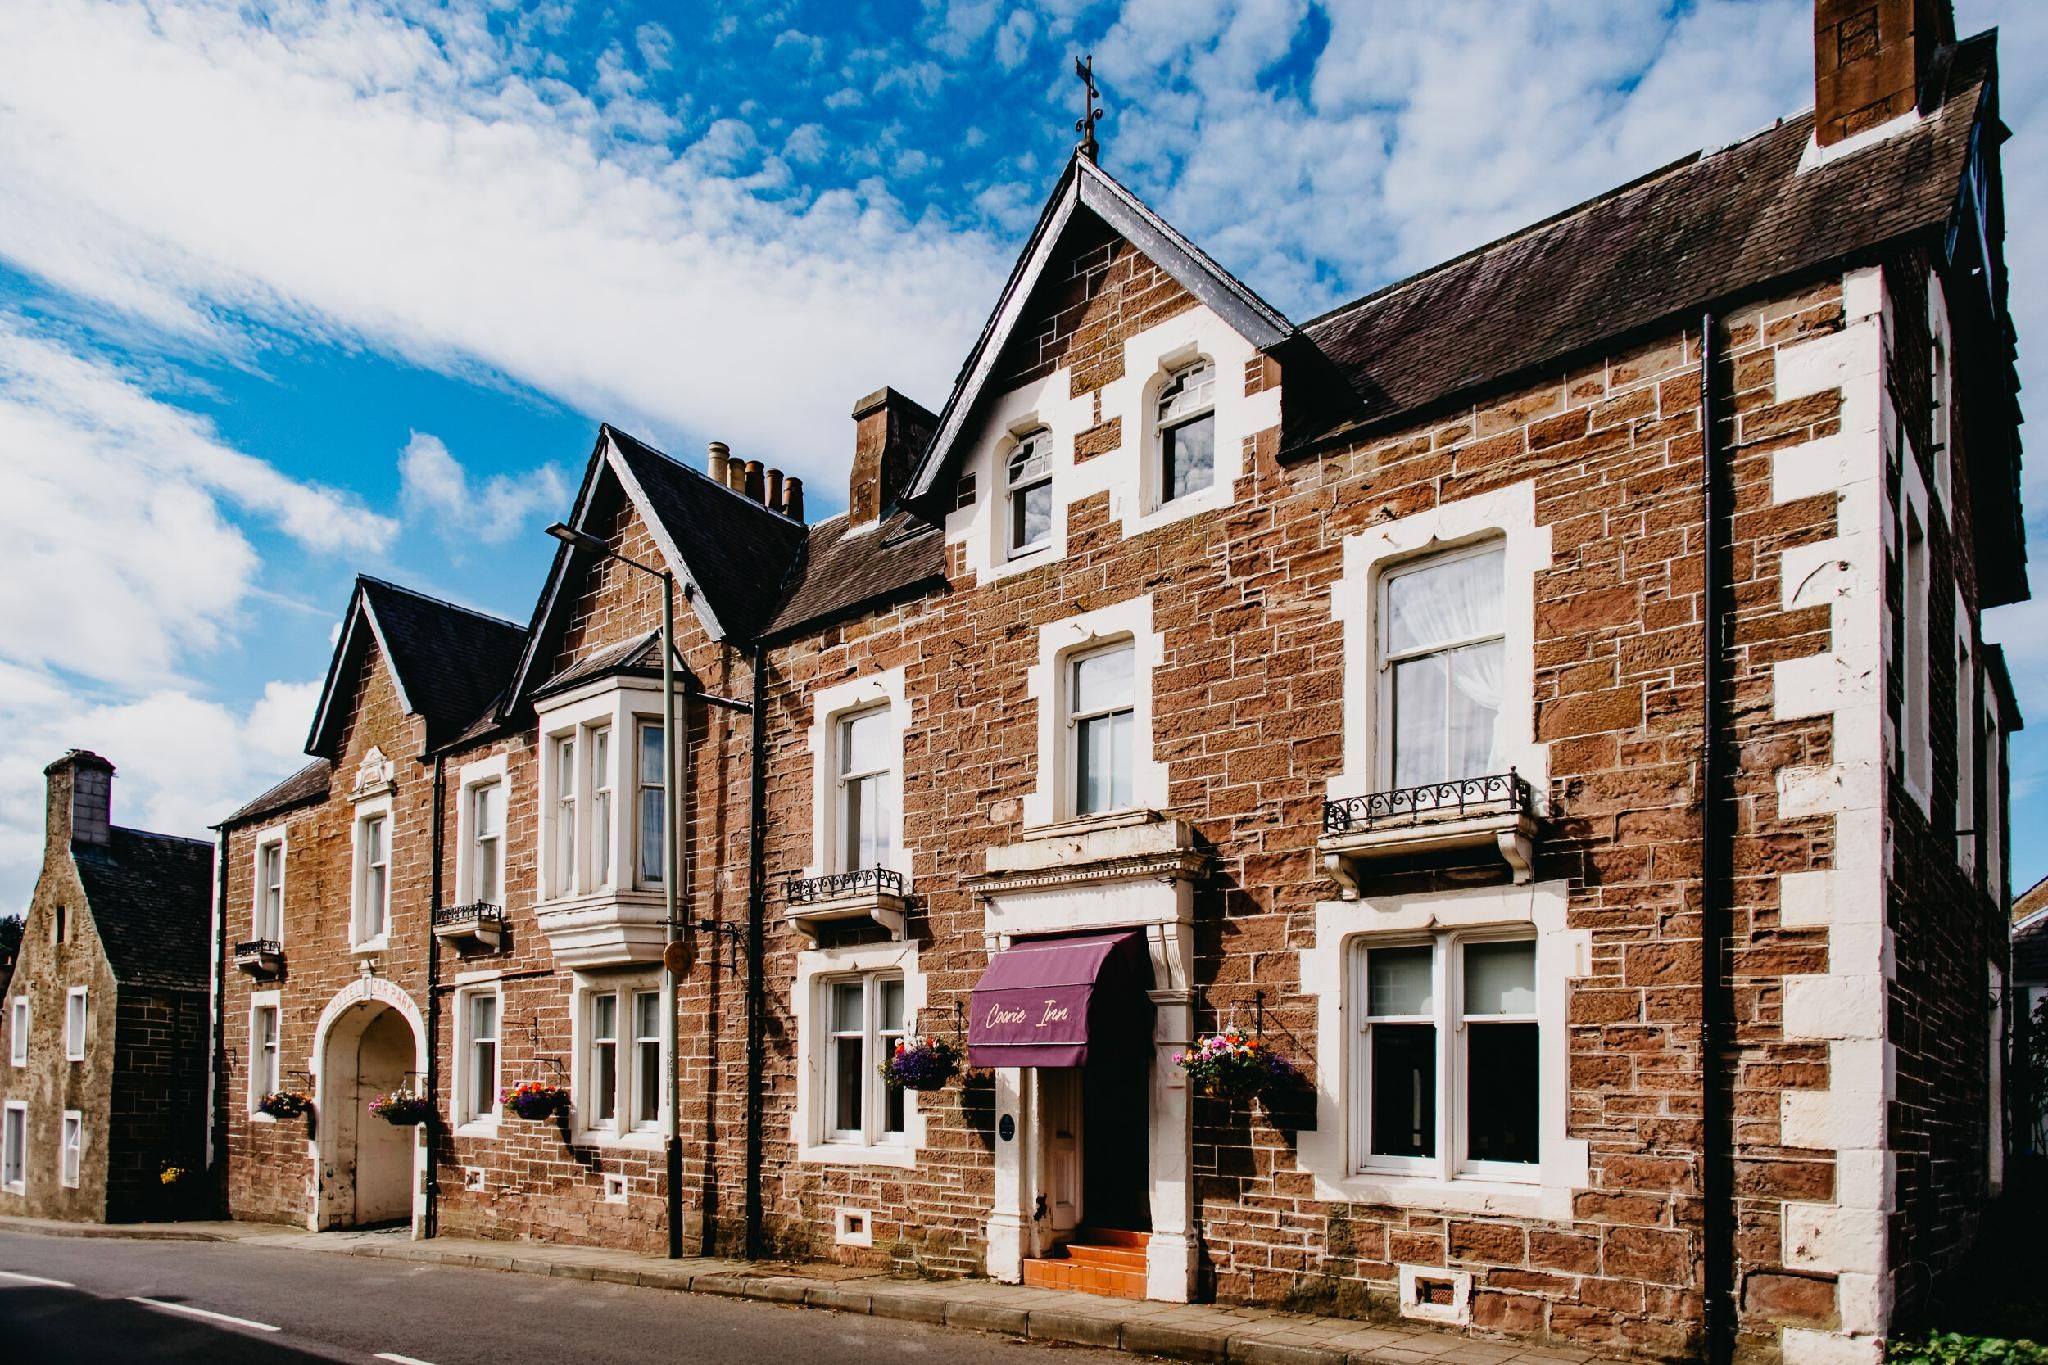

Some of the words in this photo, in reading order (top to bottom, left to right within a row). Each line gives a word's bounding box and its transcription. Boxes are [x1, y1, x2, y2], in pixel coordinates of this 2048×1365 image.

[332, 983, 361, 1010] HOTEL
[373, 980, 388, 993] CAR
[392, 987, 413, 1013] PARK
[986, 1003, 1026, 1028] Coorie
[1035, 1000, 1068, 1027] Inn
